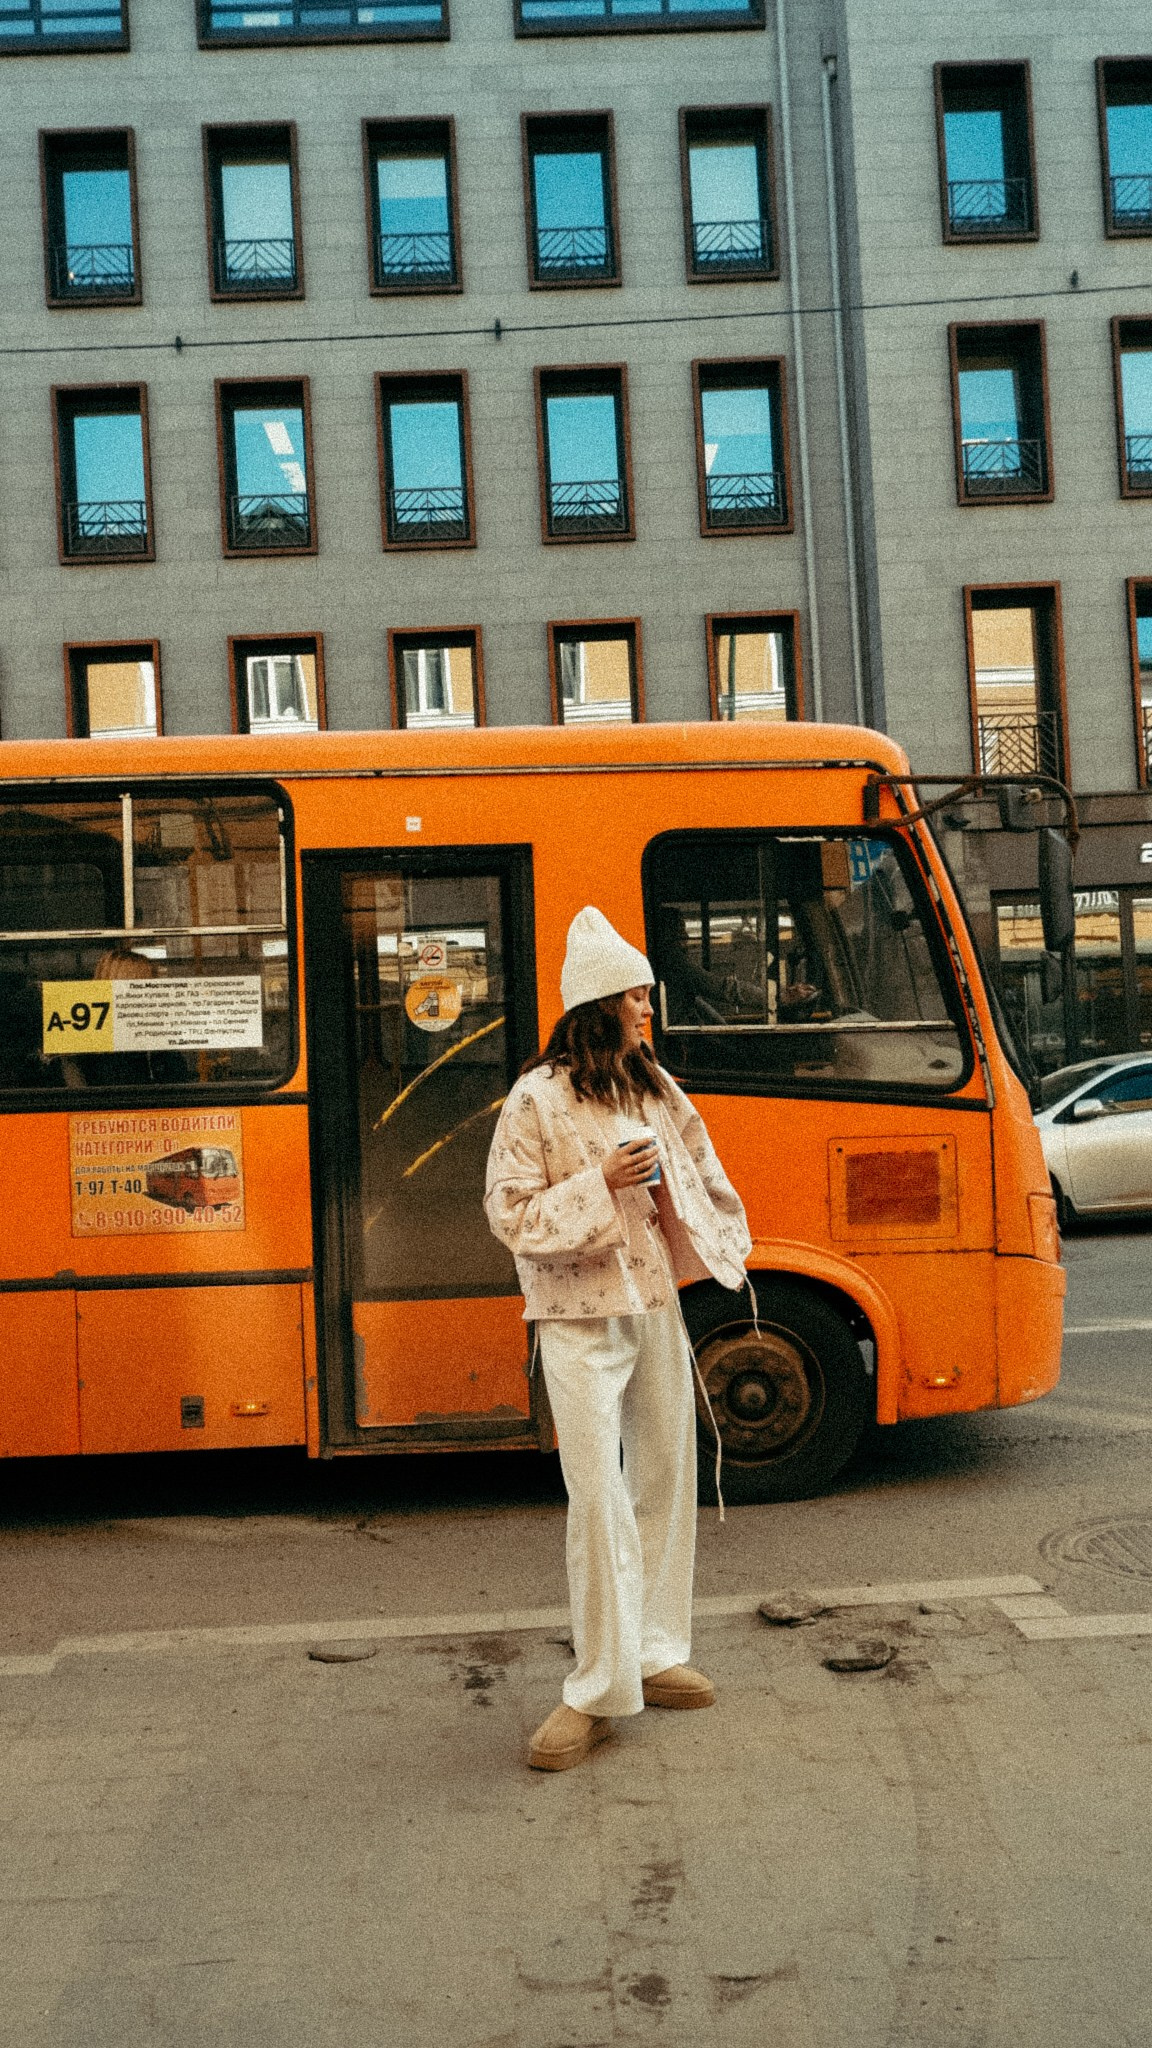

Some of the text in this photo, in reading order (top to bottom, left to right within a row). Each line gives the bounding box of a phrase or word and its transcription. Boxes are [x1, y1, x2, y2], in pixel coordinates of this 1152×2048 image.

[47, 1002, 110, 1032] А-97
[75, 1115, 236, 1134] ТРЕБУЮТСЯ ВОДИТЕЛИ
[75, 1140, 153, 1156] КАТЕГОРИИ
[110, 1179, 142, 1194] Т-40
